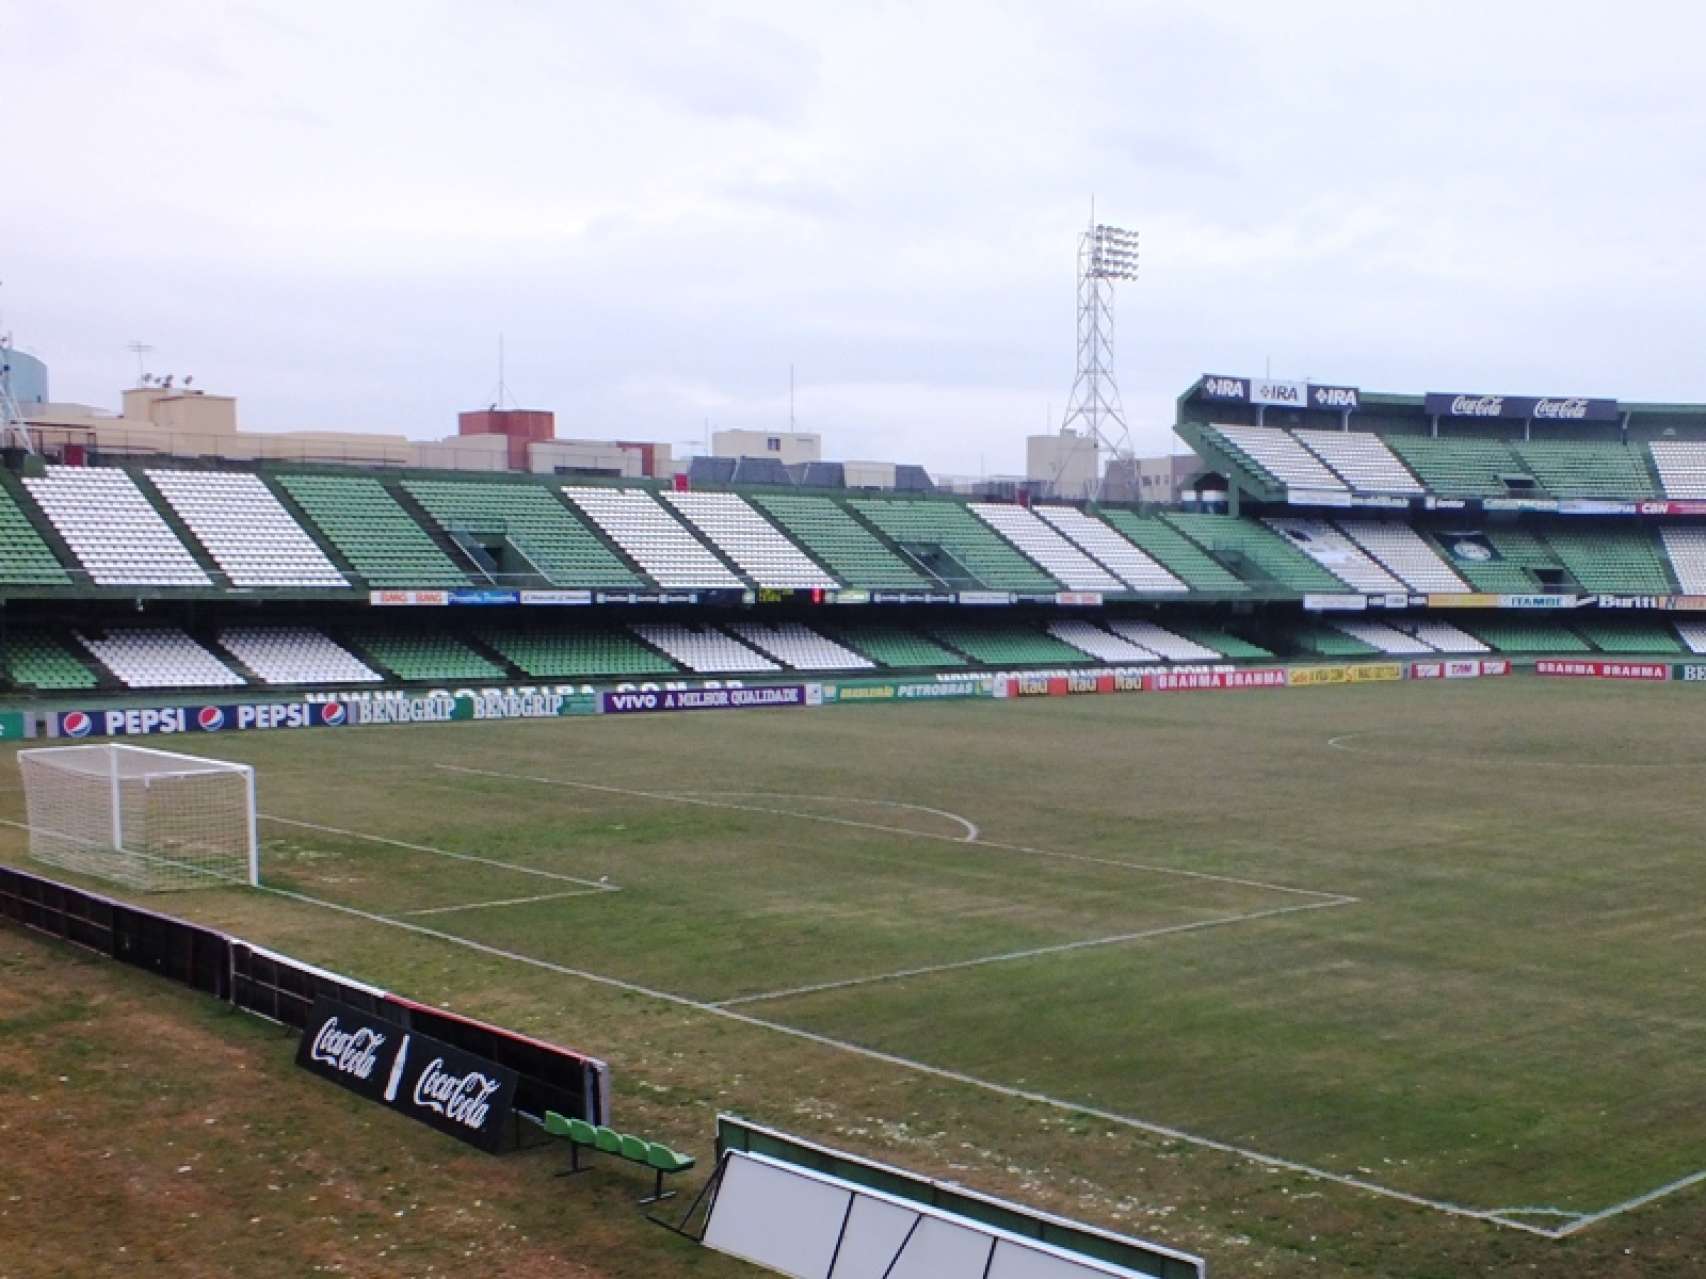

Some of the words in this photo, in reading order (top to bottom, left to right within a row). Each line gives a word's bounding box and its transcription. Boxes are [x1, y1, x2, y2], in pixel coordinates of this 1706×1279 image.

[358, 698, 455, 723] BENEGRIP
[472, 694, 564, 719] BENEGRIP
[612, 695, 658, 709] VIVO
[664, 694, 675, 707] A
[677, 692, 728, 707] MELHOR
[731, 688, 798, 705] QUALIDADE
[105, 708, 186, 735] PEPSI
[237, 702, 310, 729] PEPSI
[310, 1016, 386, 1080] Coca-Cola
[413, 1057, 501, 1129] Coca-Cola
